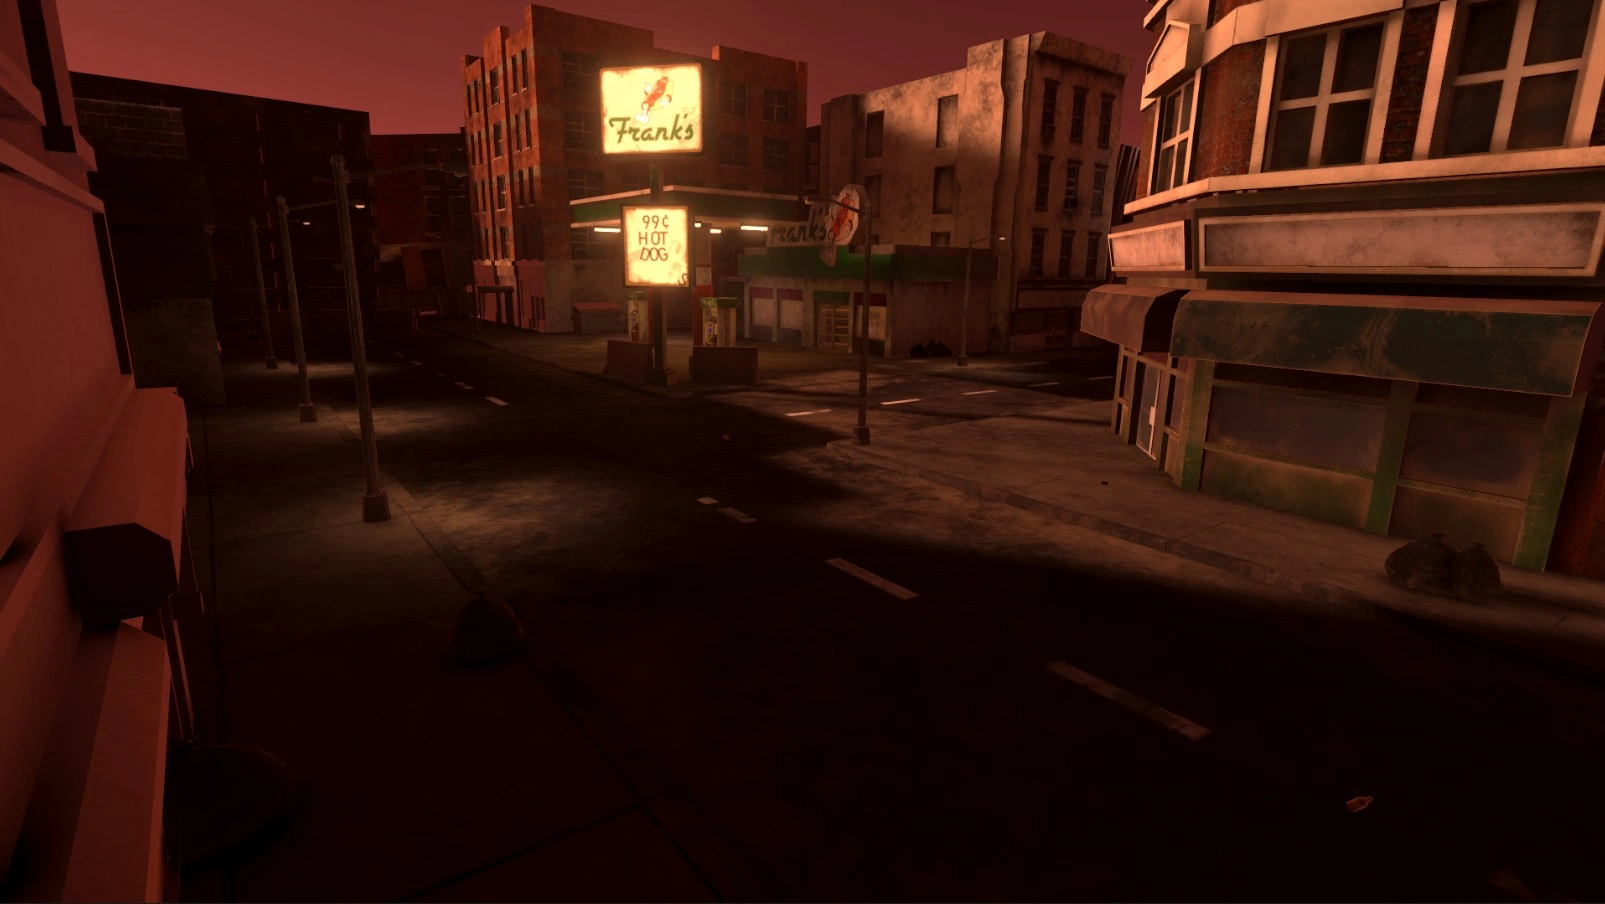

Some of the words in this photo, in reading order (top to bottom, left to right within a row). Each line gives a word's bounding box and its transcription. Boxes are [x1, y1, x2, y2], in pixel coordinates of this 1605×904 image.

[608, 113, 694, 144] Frank's
[642, 214, 669, 230] 99¢
[638, 231, 668, 246] HOT
[639, 247, 669, 261] DOG
